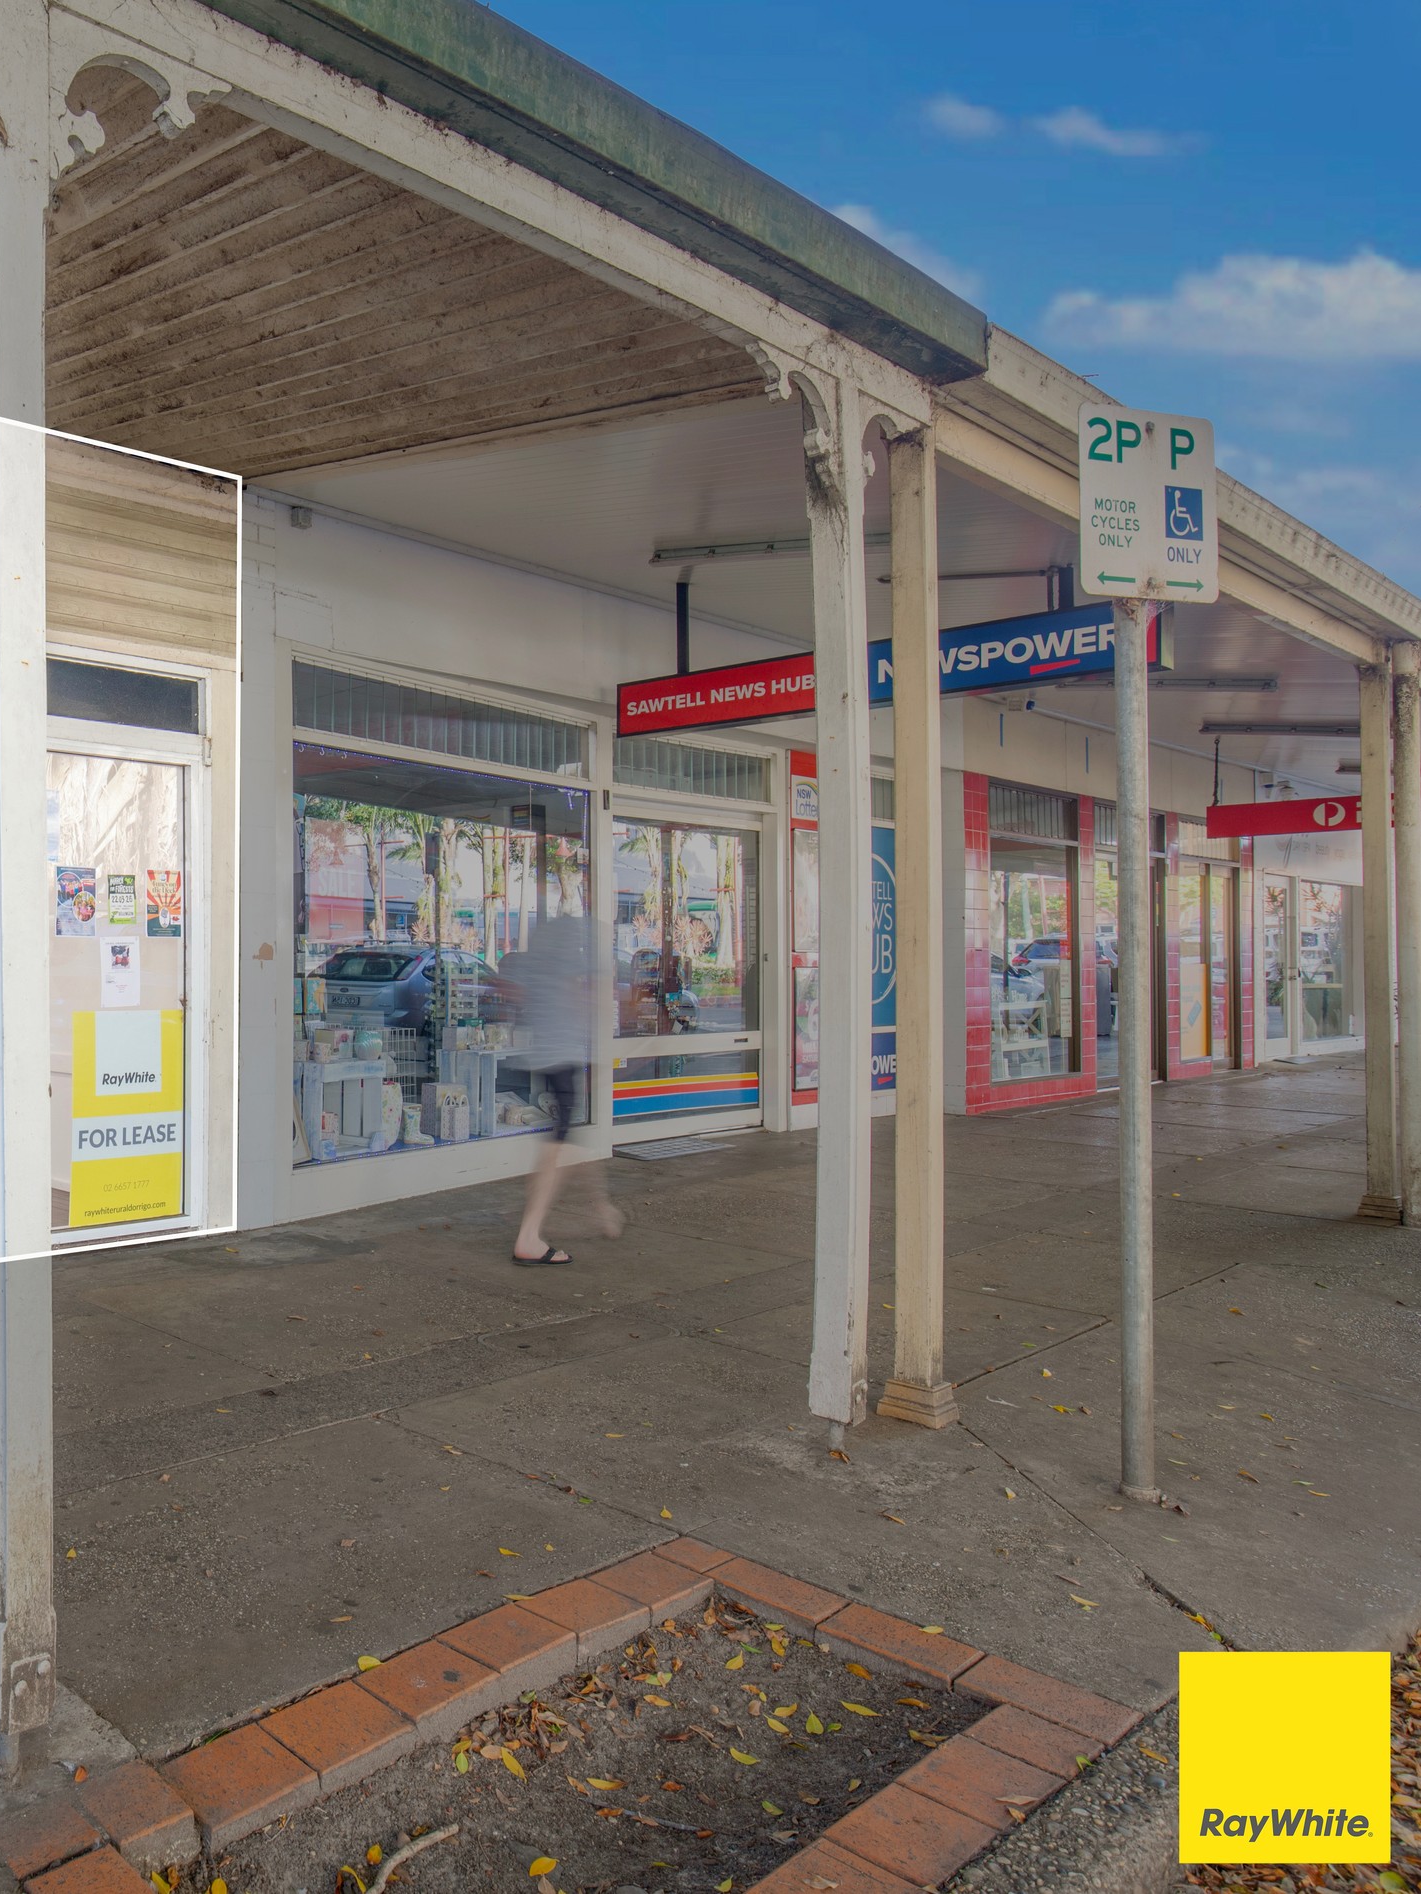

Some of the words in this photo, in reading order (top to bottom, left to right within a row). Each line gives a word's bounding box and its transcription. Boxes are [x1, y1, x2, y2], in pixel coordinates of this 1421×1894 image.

[1087, 417, 1141, 463] 2P
[1170, 428, 1195, 470] P
[1094, 497, 1136, 514] MOTOR
[1091, 515, 1140, 531] CYCLES
[1099, 533, 1132, 548] ONLY
[1167, 546, 1202, 564] ONLY
[877, 622, 1115, 684] NWSPOWER
[626, 692, 705, 717] SAWTELL
[710, 681, 766, 704] NEWS
[771, 674, 815, 694] HUB
[797, 788, 811, 799] NSW
[872, 880, 893, 900] TELL
[102, 1071, 156, 1086] RayWhite
[78, 1127, 117, 1149] FOR
[122, 1123, 176, 1146] LEASE
[103, 1183, 112, 1192] 02
[113, 1181, 131, 1191] 6657
[133, 1180, 149, 1189] 1777
[84, 1201, 166, 1217] raywhiteruraldorrigo.com
